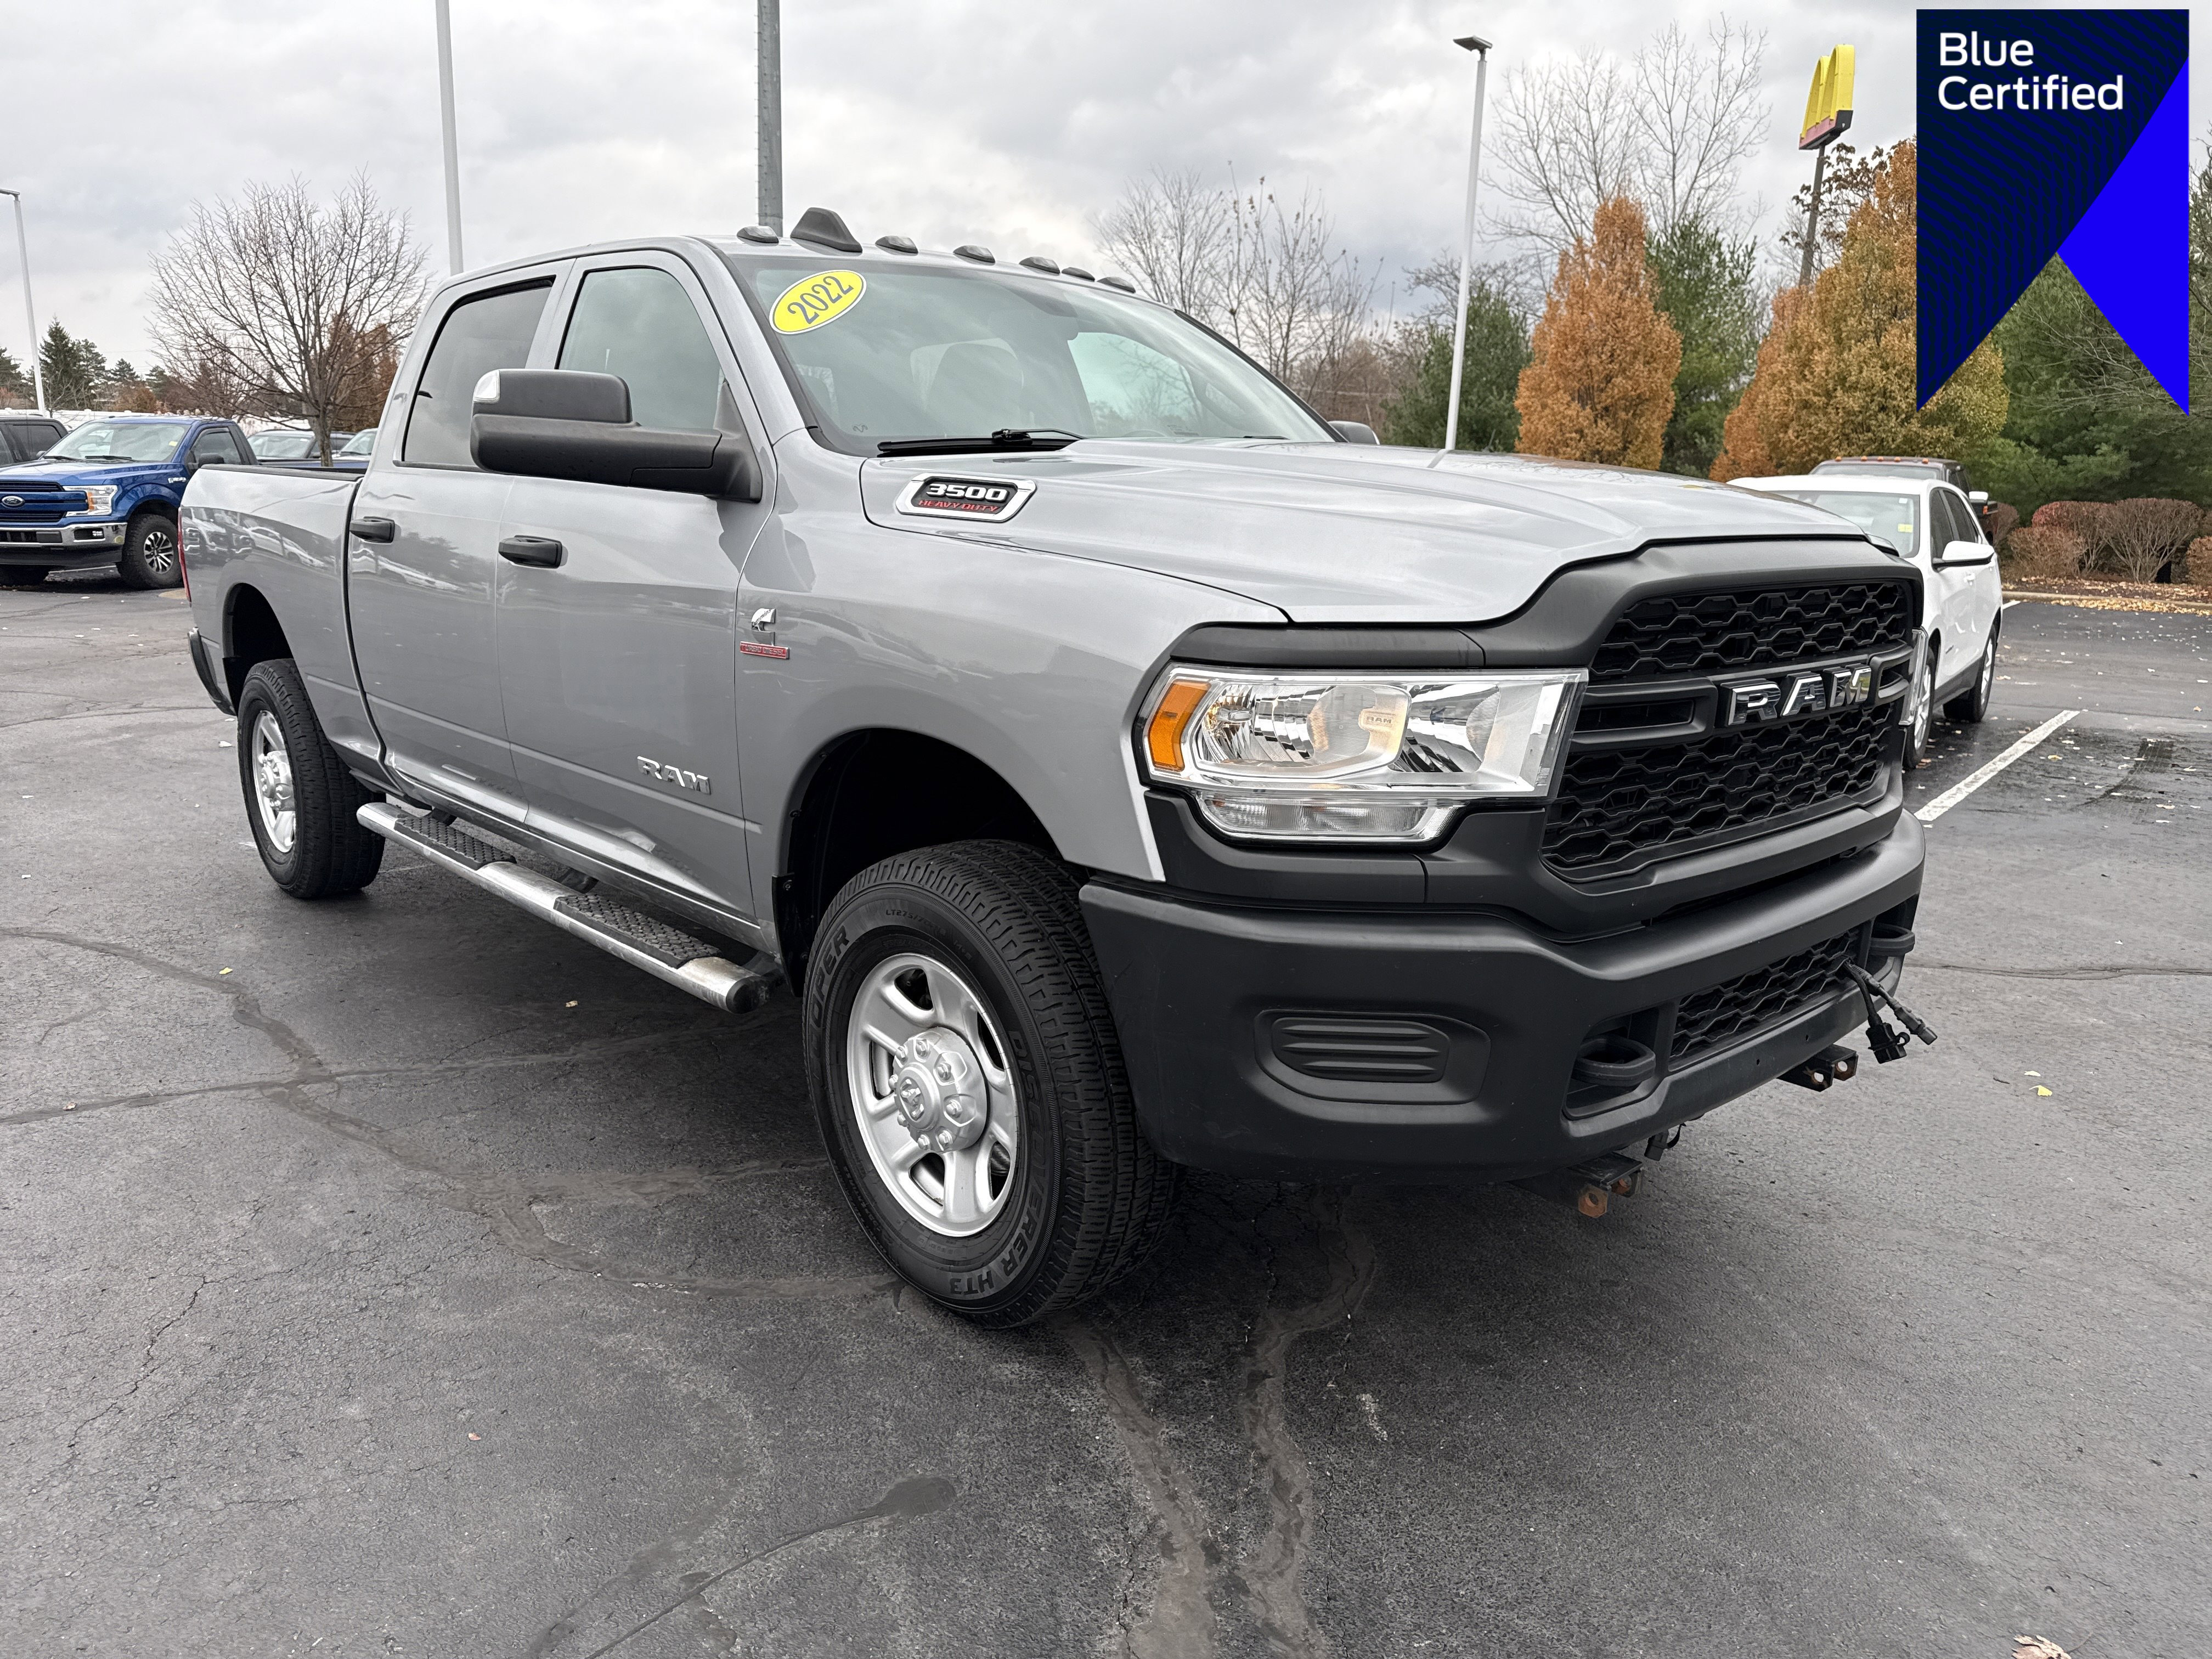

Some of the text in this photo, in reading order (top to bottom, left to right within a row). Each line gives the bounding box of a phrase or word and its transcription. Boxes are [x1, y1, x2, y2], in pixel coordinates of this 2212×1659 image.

[787, 276, 854, 324] 2022
[918, 500, 998, 512] HEAVY DUTY
[926, 483, 1008, 501] 3500
[1726, 665, 1871, 726] RAM
[637, 756, 711, 795] RAM
[950, 1270, 994, 1295] HT3
